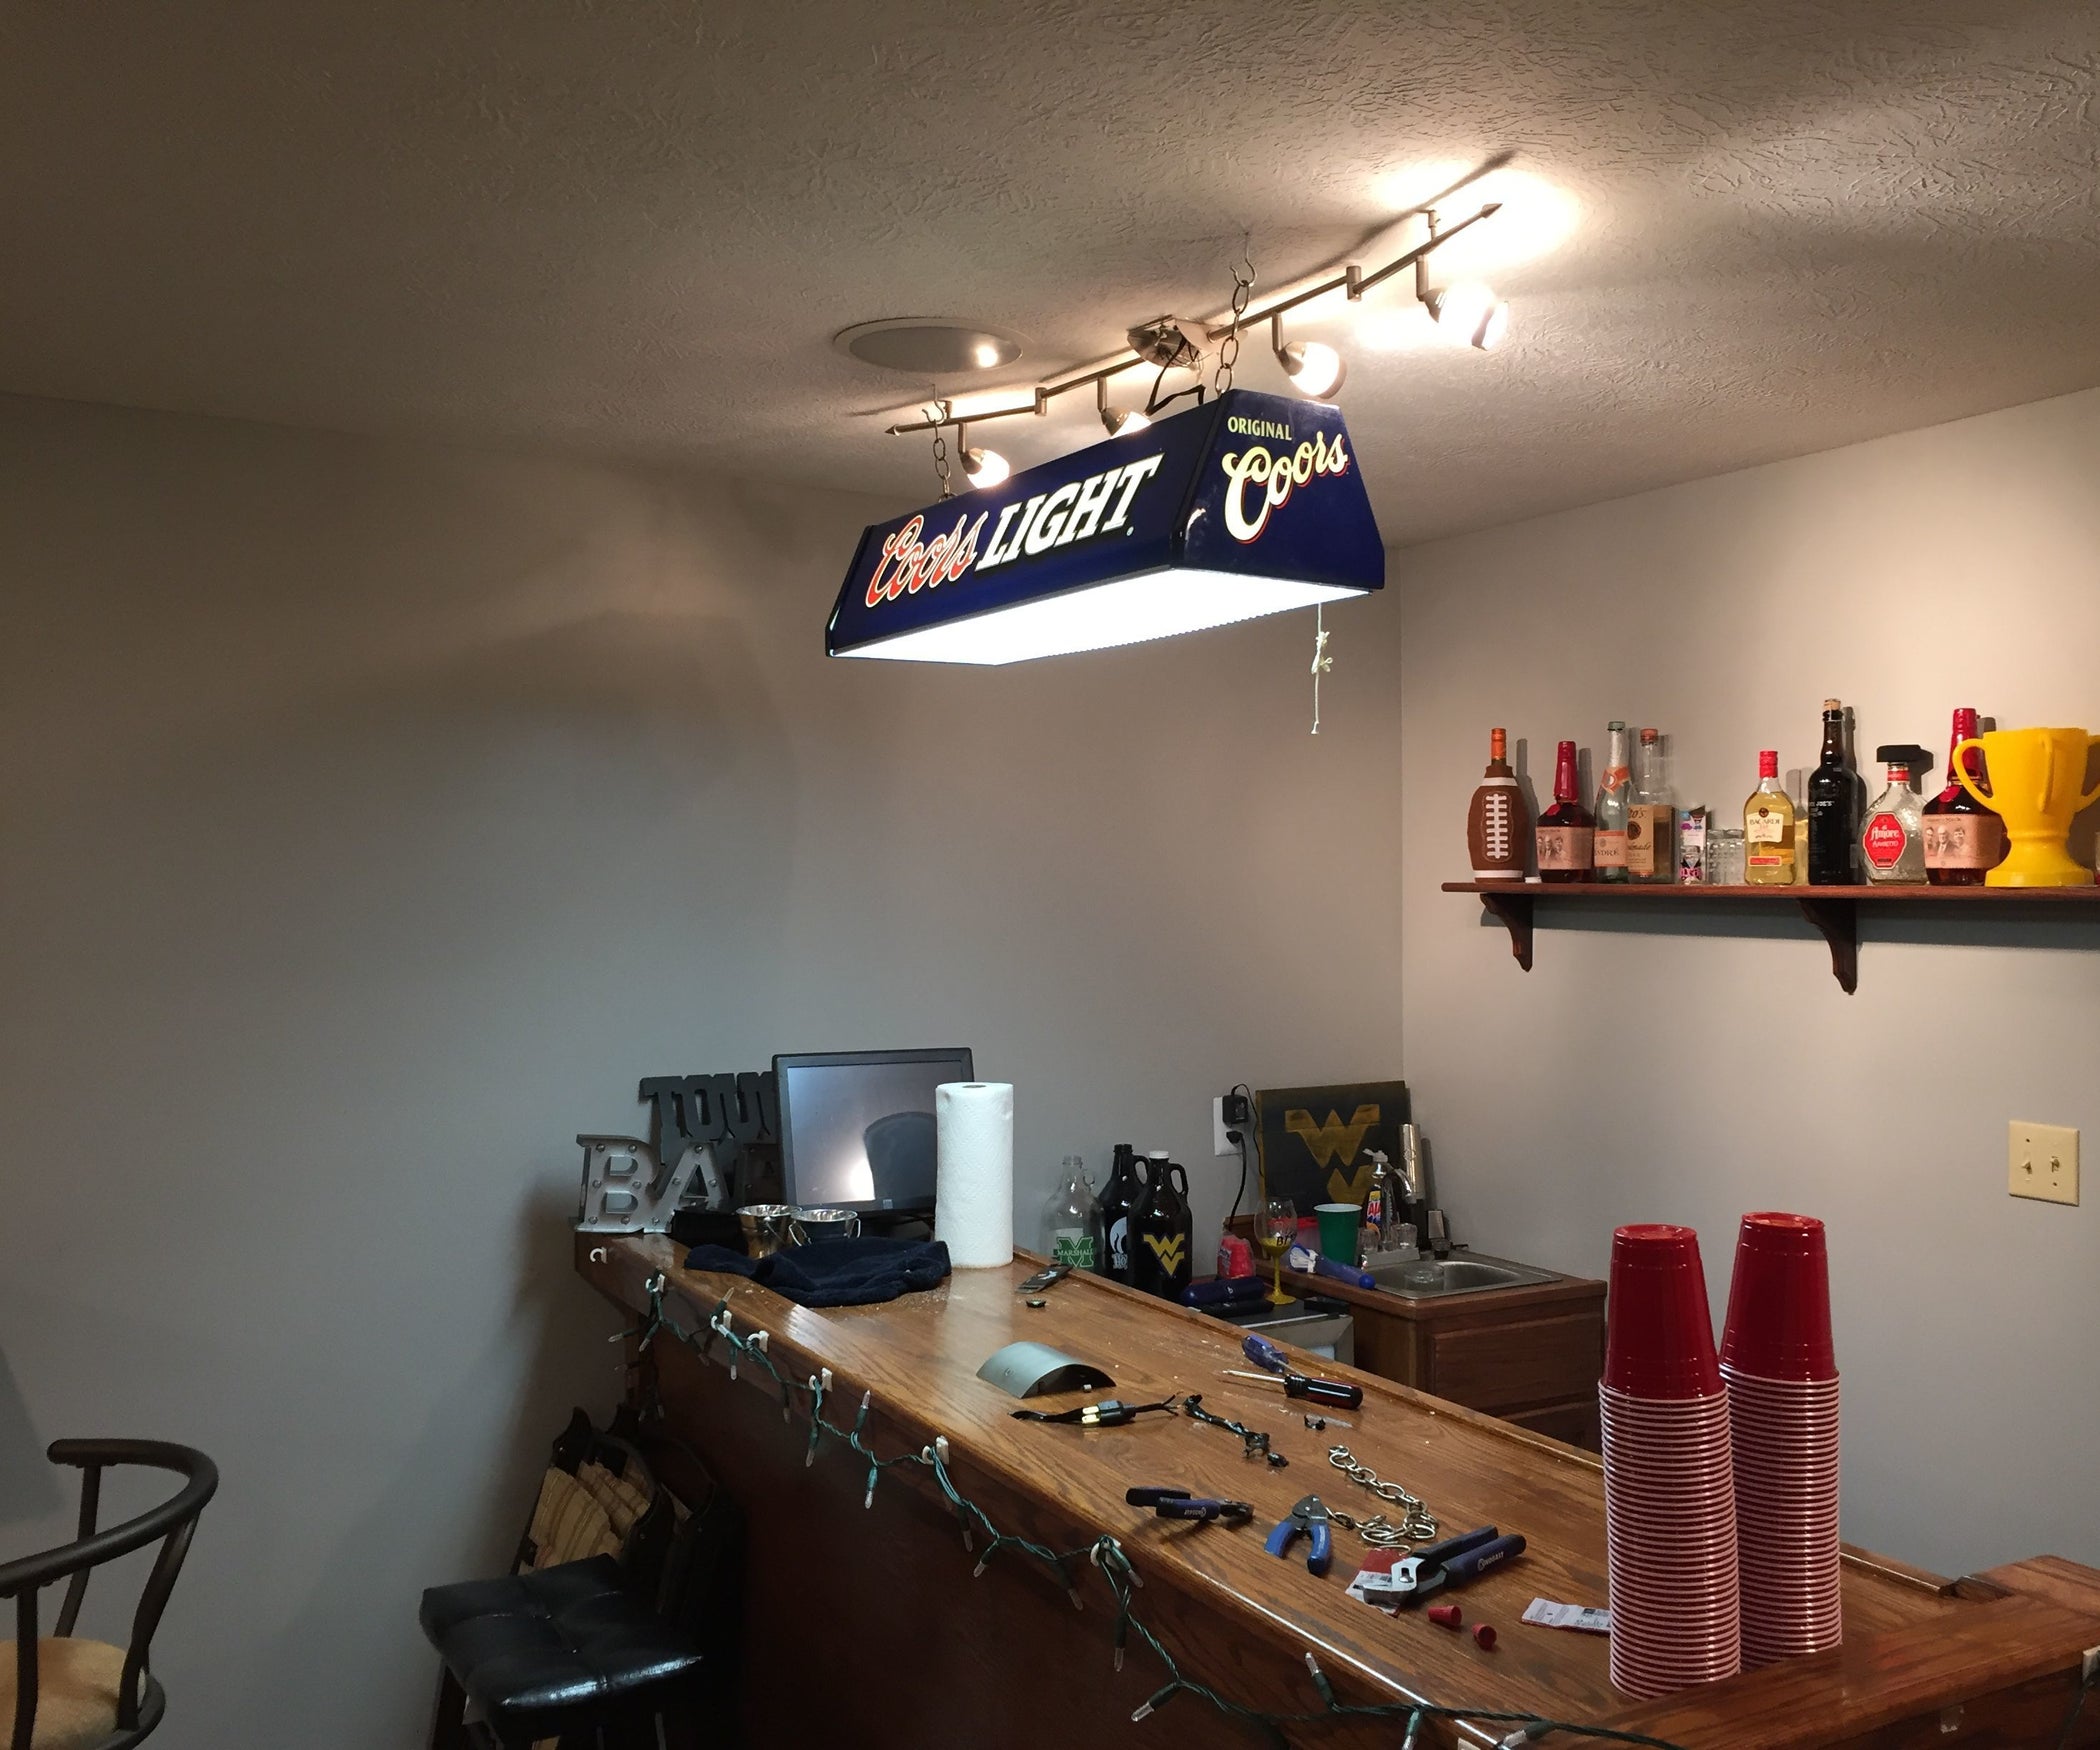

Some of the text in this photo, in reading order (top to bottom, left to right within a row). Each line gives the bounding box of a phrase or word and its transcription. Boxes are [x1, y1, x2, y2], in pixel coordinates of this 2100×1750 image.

[1228, 416, 1292, 441] ORIGINAL
[865, 453, 1166, 608] Coors LIGHT
[1222, 430, 1349, 544] Coors
